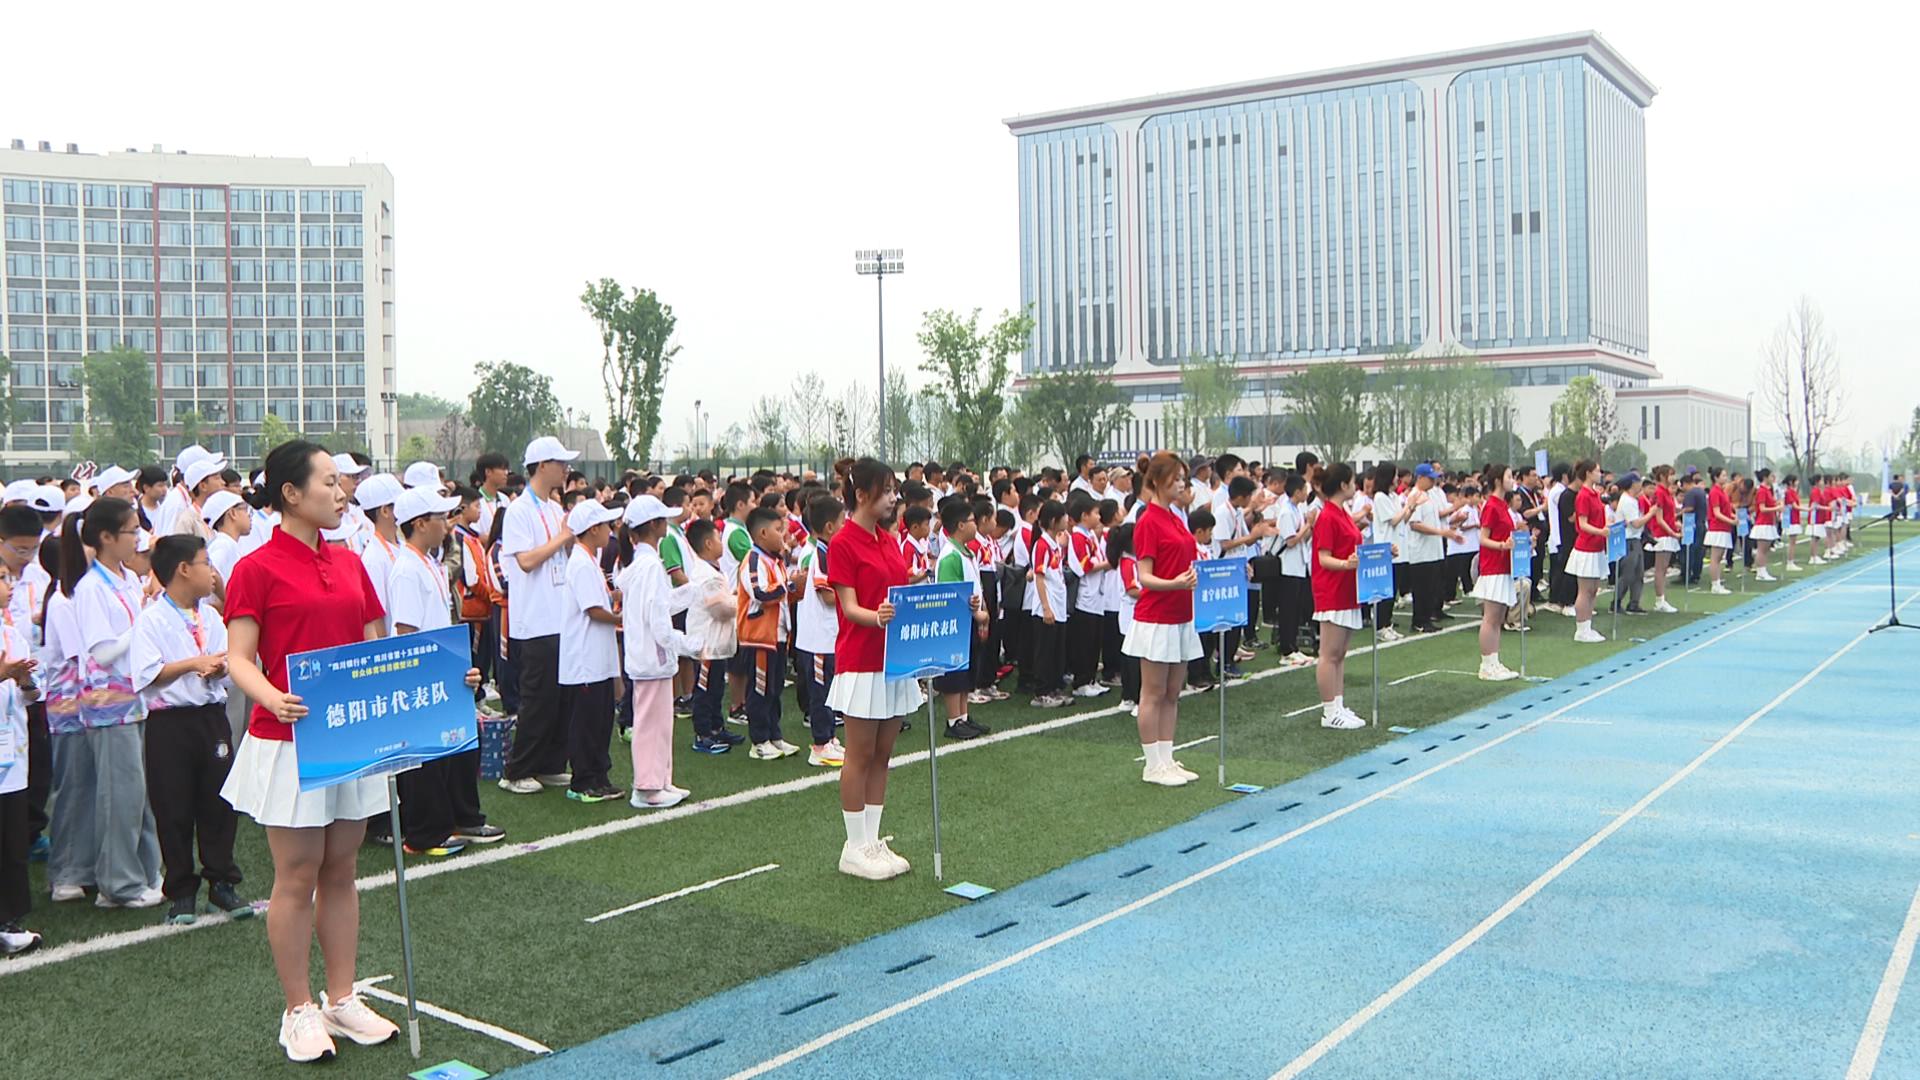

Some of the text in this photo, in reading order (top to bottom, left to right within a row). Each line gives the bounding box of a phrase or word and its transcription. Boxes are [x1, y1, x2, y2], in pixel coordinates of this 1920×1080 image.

[900, 619, 958, 641] 绵阳市代表队
[325, 681, 449, 729] 德阳市代表队
